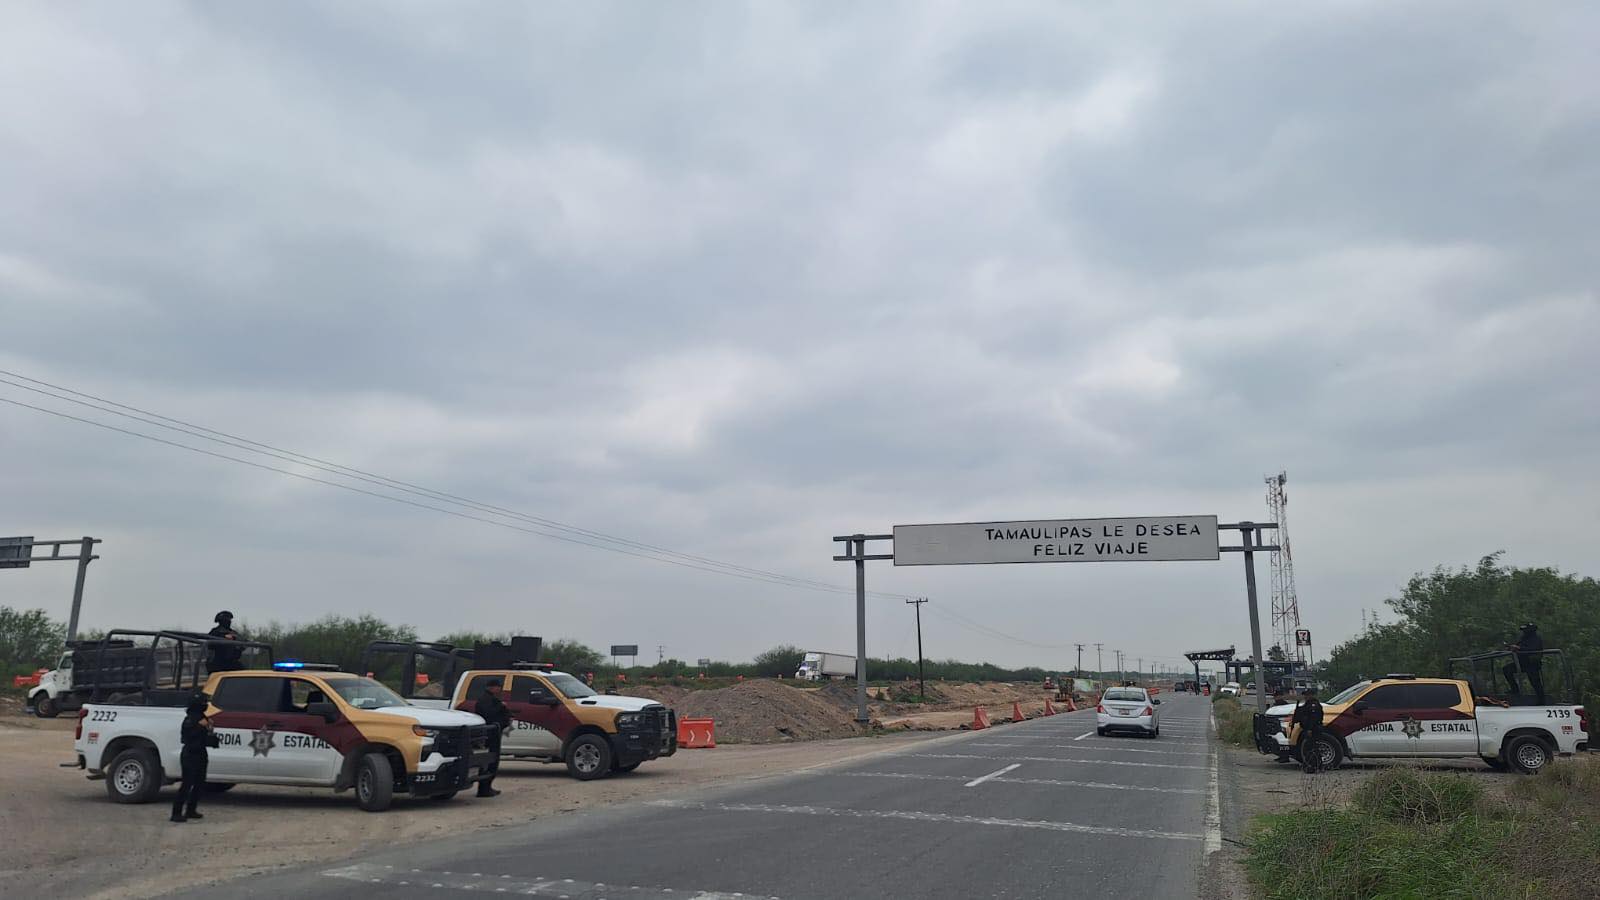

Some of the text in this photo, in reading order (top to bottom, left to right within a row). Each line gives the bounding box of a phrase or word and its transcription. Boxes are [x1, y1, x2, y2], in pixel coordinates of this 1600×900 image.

[985, 523, 1201, 540] TAMAULIPAS LE DESEA
[1033, 542, 1148, 556] FELIZ VIAJE
[91, 710, 118, 722] 2232
[1545, 709, 1571, 719] 2139
[1431, 723, 1472, 732] ESTATAL
